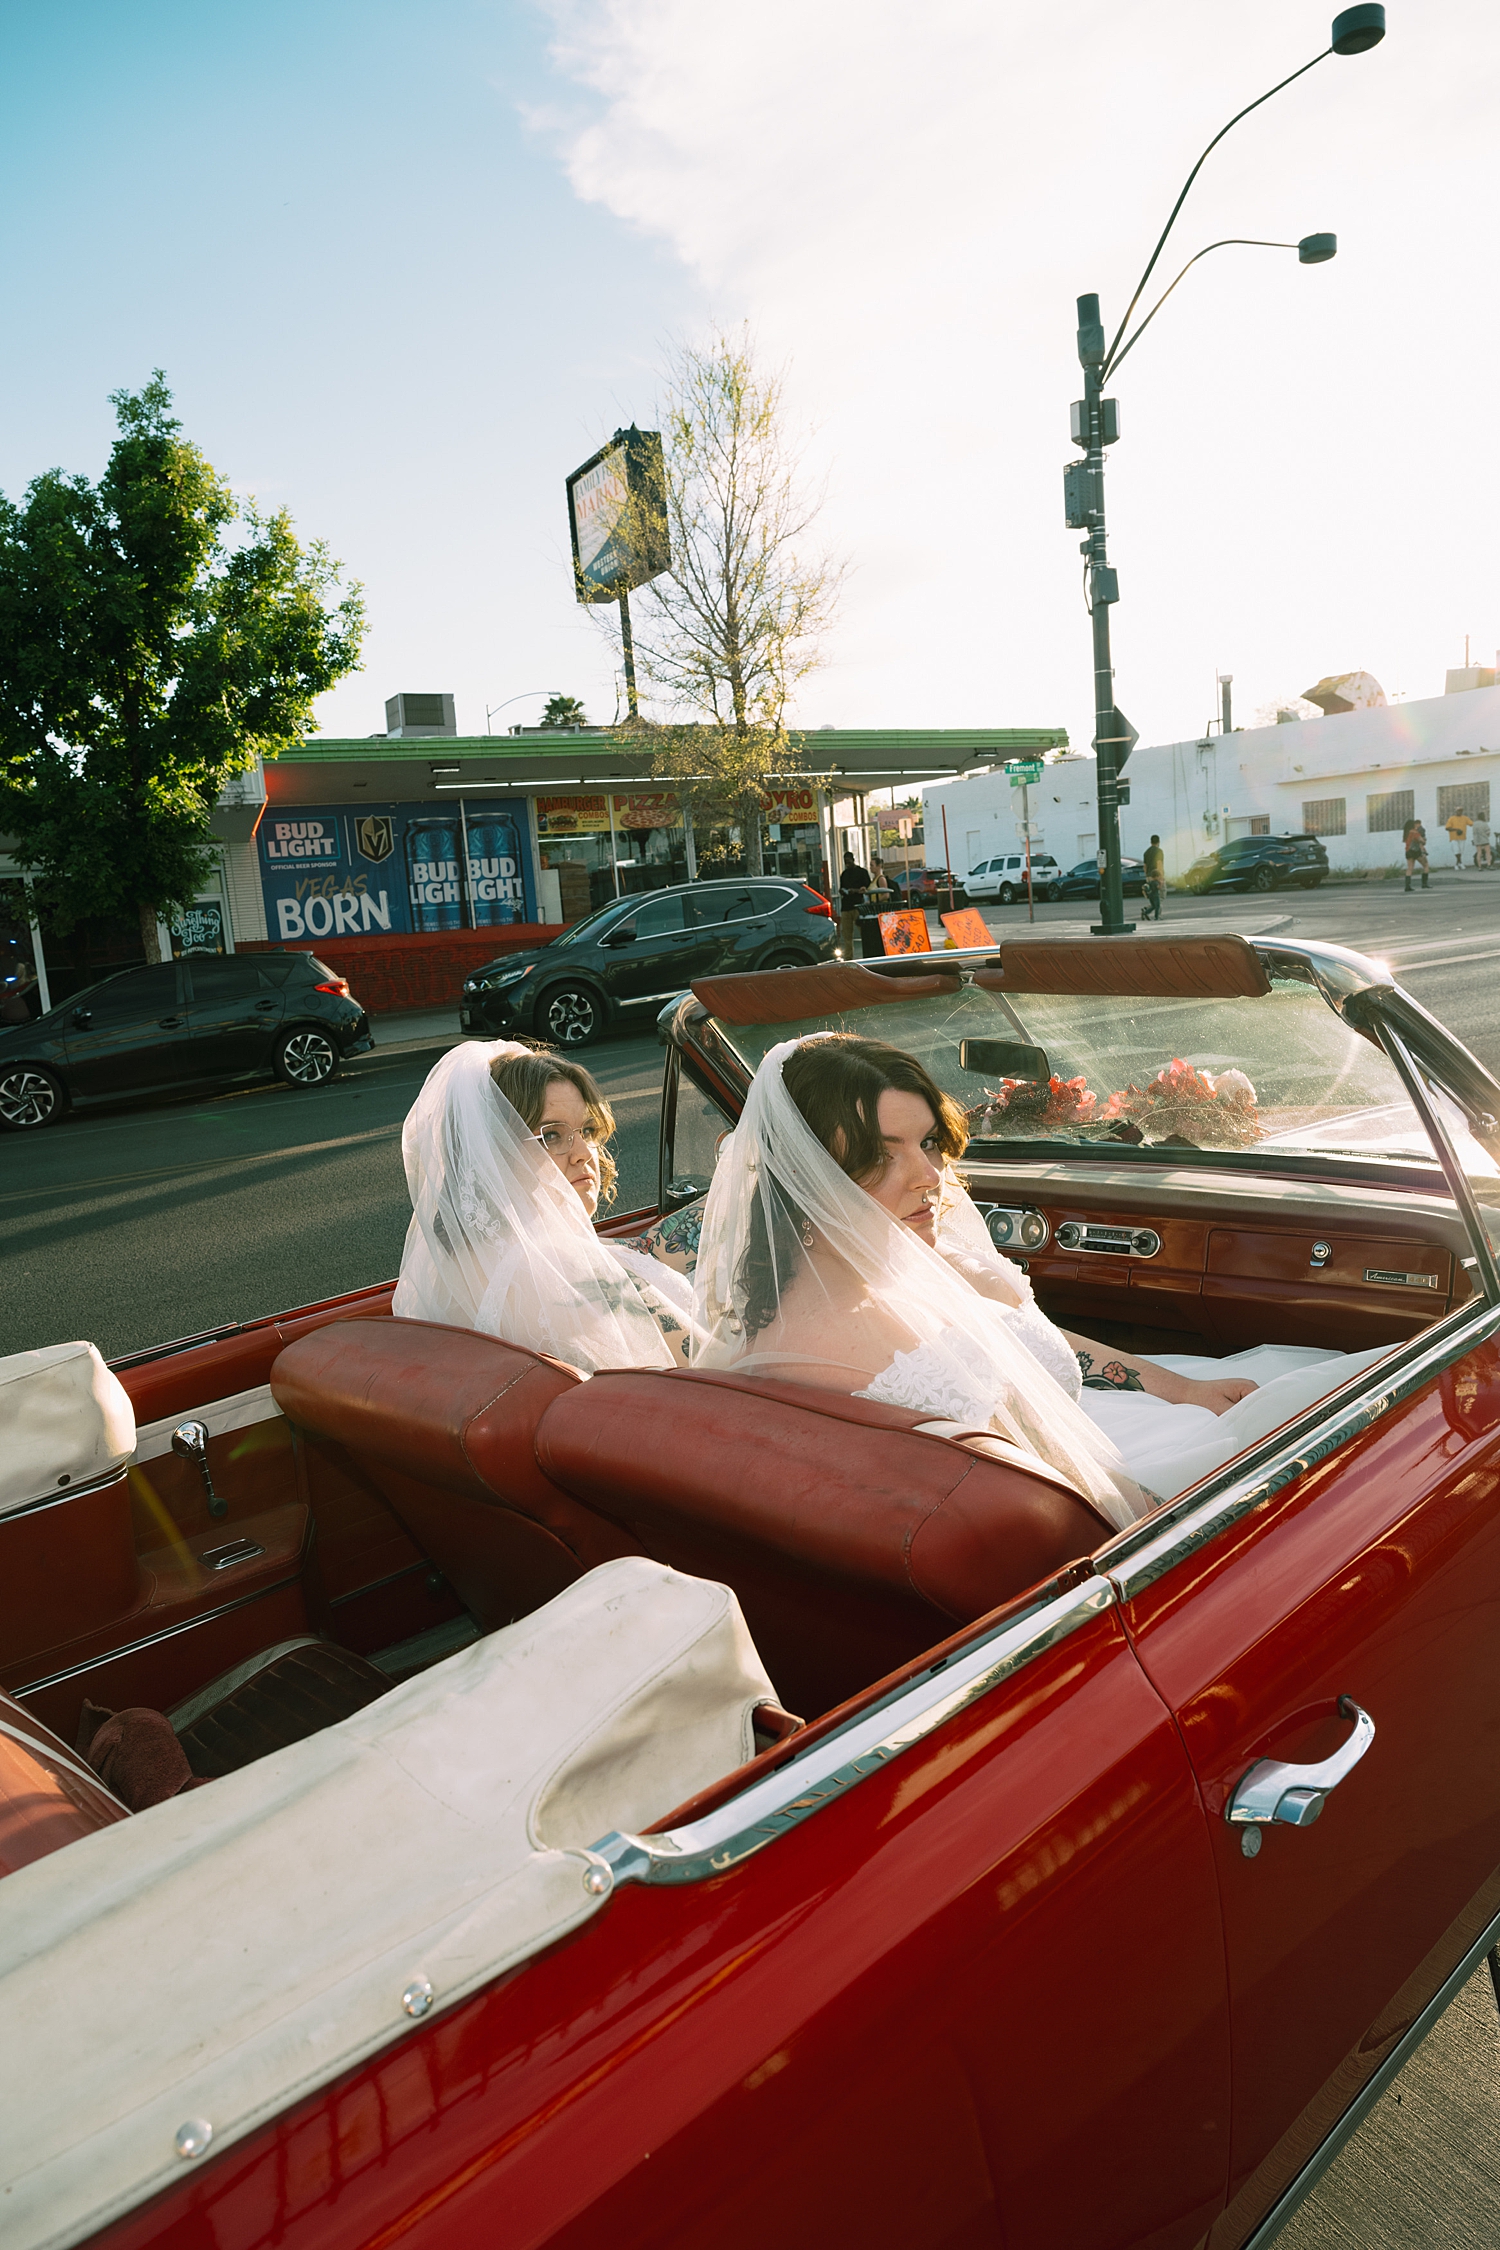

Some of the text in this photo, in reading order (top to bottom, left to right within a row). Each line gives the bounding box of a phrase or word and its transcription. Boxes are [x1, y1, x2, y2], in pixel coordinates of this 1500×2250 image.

[574, 468, 601, 501] FAMILY
[576, 470, 627, 519] MARKE
[1009, 763, 1036, 773] Fremont
[536, 795, 607, 813] HAMBURGER
[760, 789, 813, 811] GYRO
[578, 810, 609, 820] COMBOS
[788, 811, 817, 822] COMBOS
[275, 822, 324, 840] BUD
[267, 838, 334, 858] LIGHT
[270, 863, 295, 871] OFFICIAL
[310, 861, 337, 869] SPONSOR
[412, 861, 460, 883] BUD
[468, 857, 516, 880] BUD
[295, 873, 368, 900] VEGAS
[409, 881, 461, 905] LIGH
[276, 890, 392, 940] BORN
[181, 926, 215, 947] Too
[1369, 1272, 1405, 1283] American
